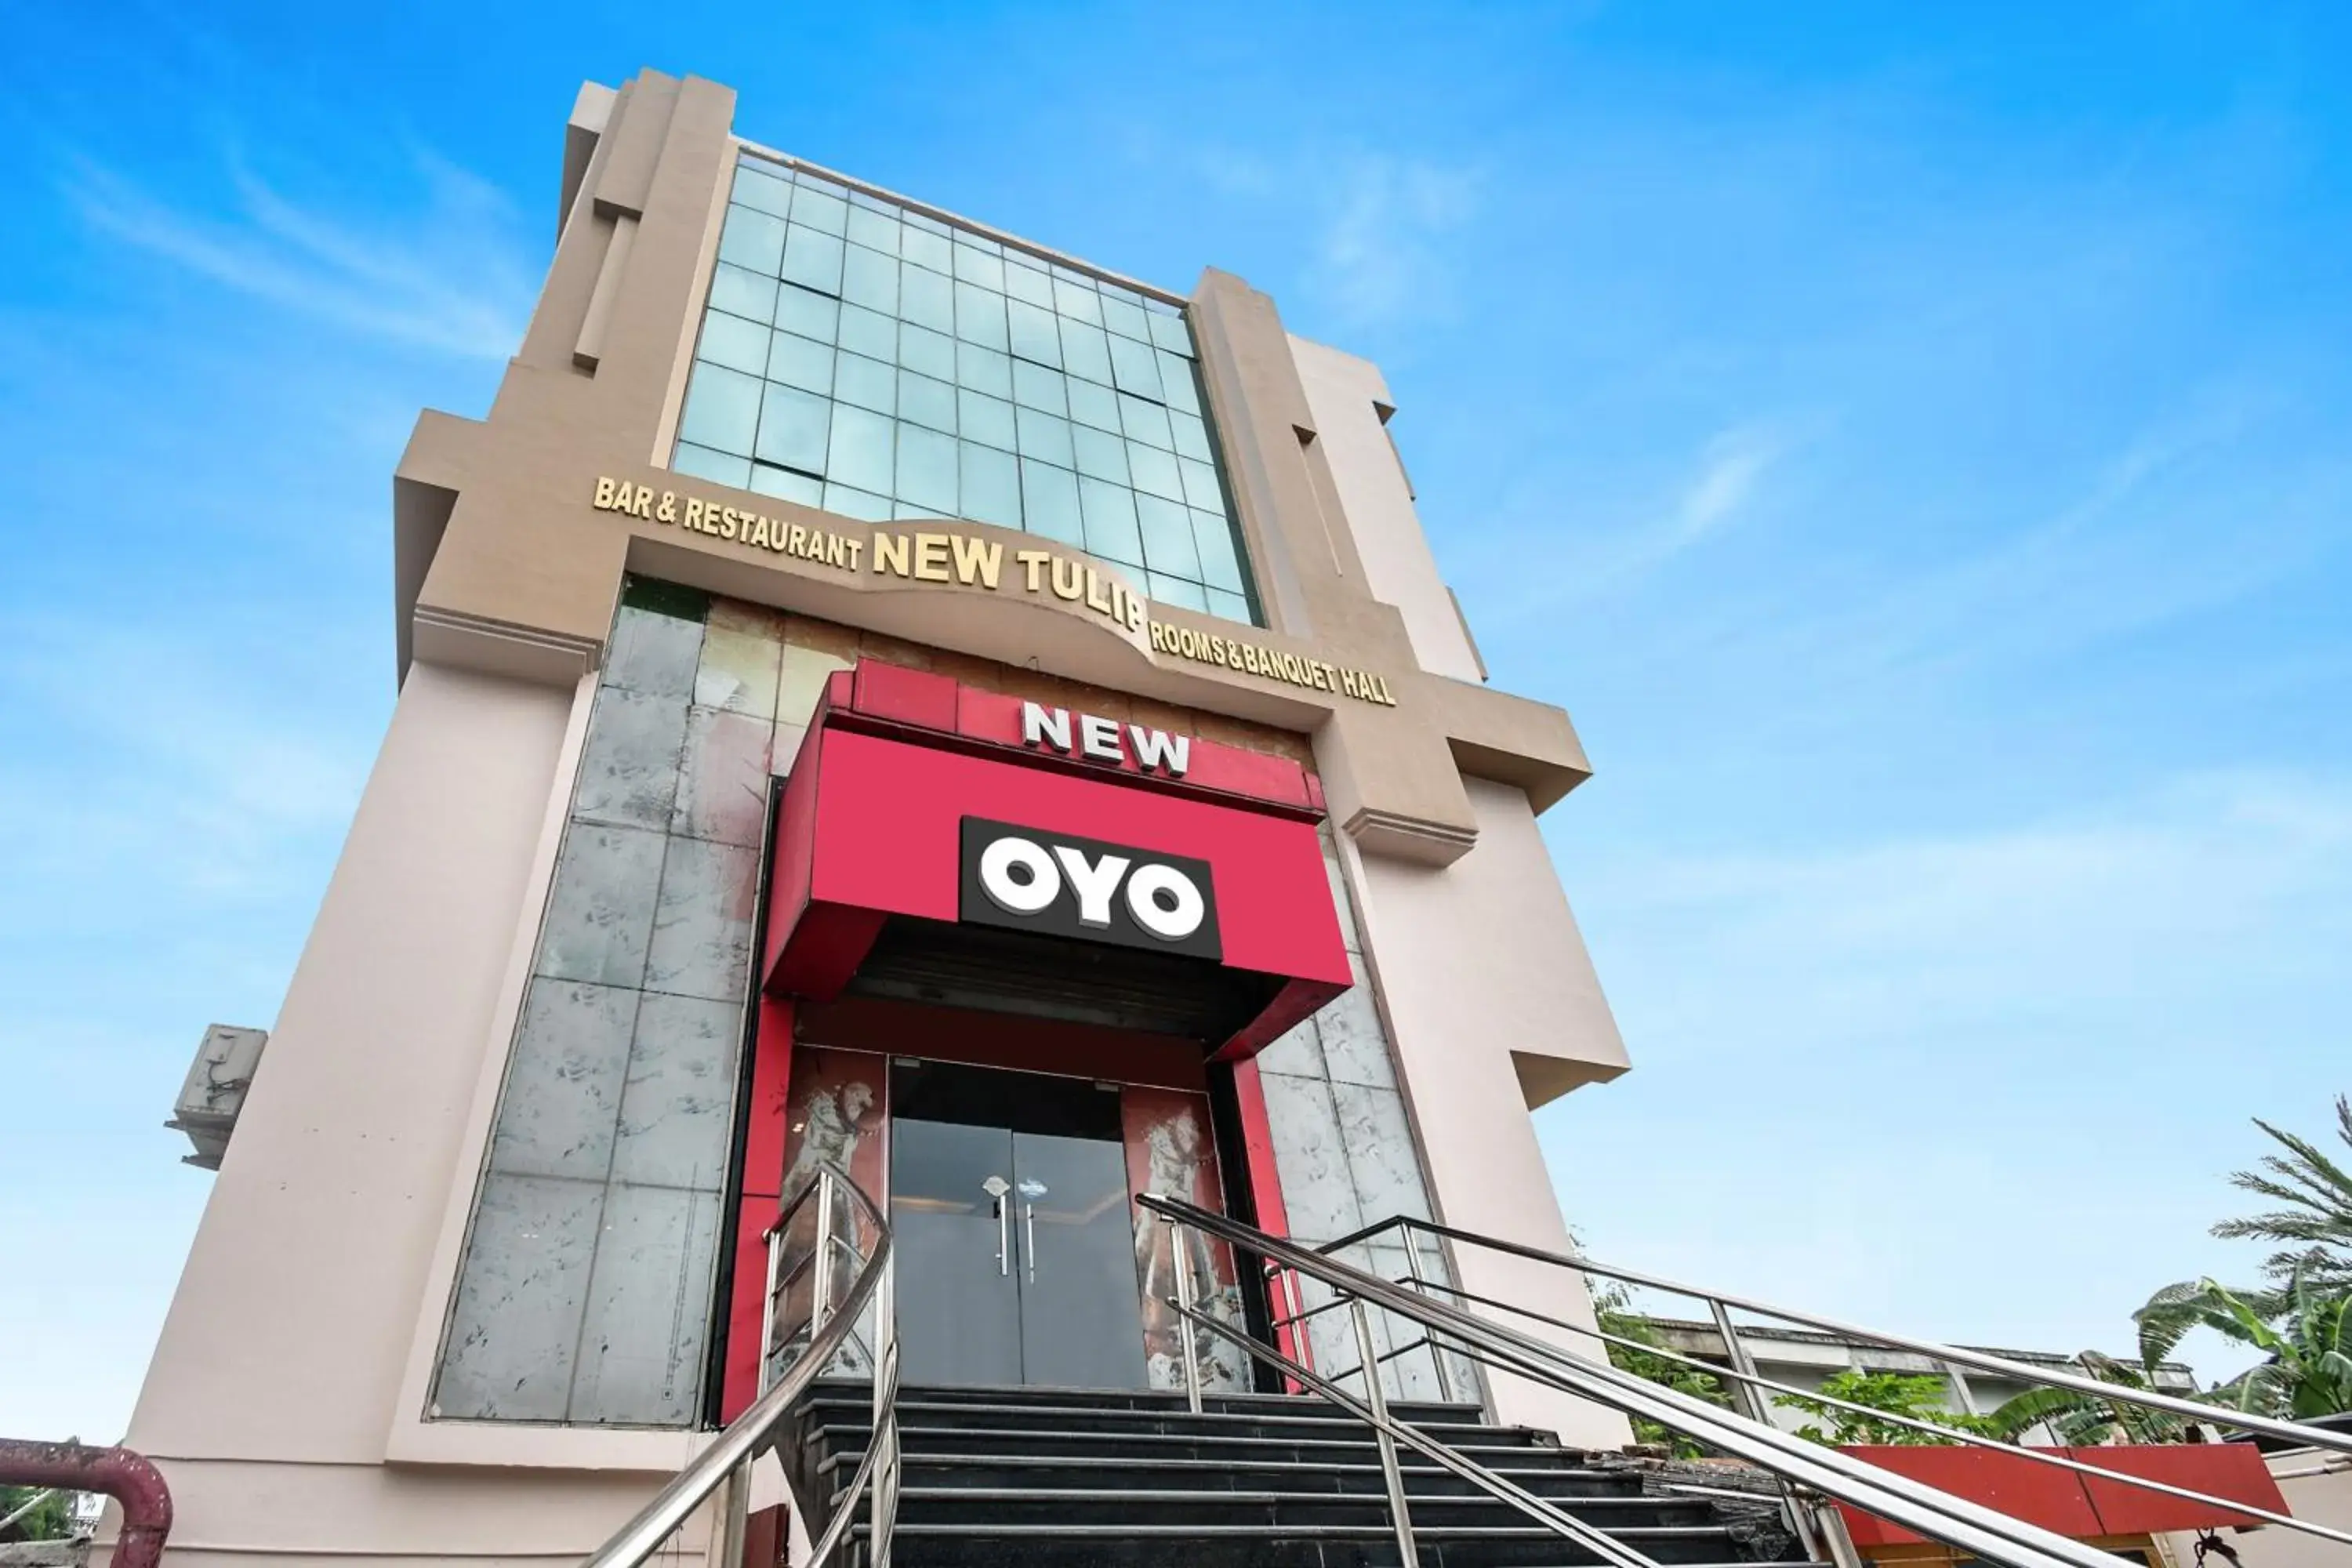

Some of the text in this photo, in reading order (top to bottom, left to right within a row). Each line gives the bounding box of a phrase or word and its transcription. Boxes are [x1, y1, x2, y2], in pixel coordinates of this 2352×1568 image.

[593, 476, 863, 572] BAR & RESTAURANT
[873, 532, 1145, 632] NEW TULIP
[1339, 667, 1397, 707] HALL
[1020, 701, 1190, 779] NEW
[978, 837, 1204, 942] OYO
